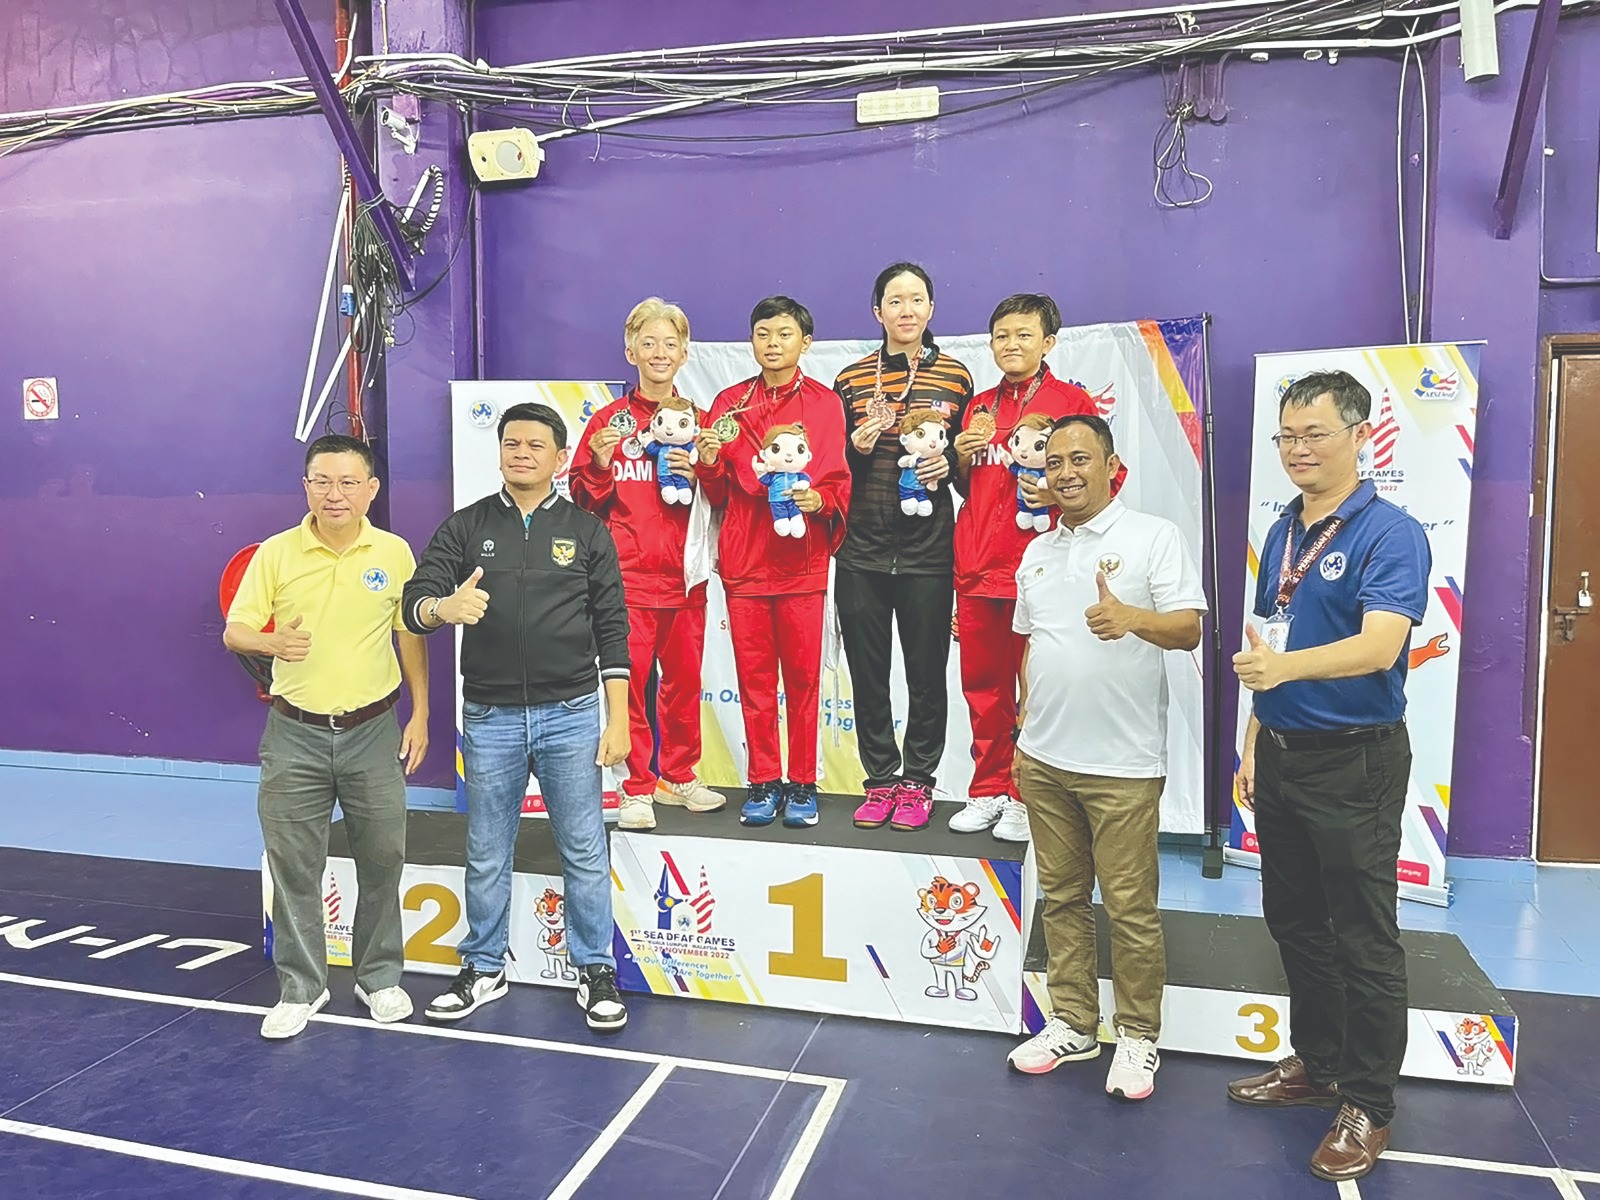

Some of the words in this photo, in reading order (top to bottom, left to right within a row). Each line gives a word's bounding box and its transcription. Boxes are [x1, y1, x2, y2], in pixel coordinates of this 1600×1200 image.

[403, 882, 463, 966] 2
[768, 872, 847, 983] 1
[644, 930, 664, 940] SEA
[666, 932, 694, 943] DEAF
[696, 935, 736, 947] GAMES
[643, 956, 659, 964] Our
[665, 947, 709, 957] NOVEMBER
[711, 951, 730, 960] 2022
[696, 970, 732, 981] Together
[1235, 1003, 1280, 1053] 3
